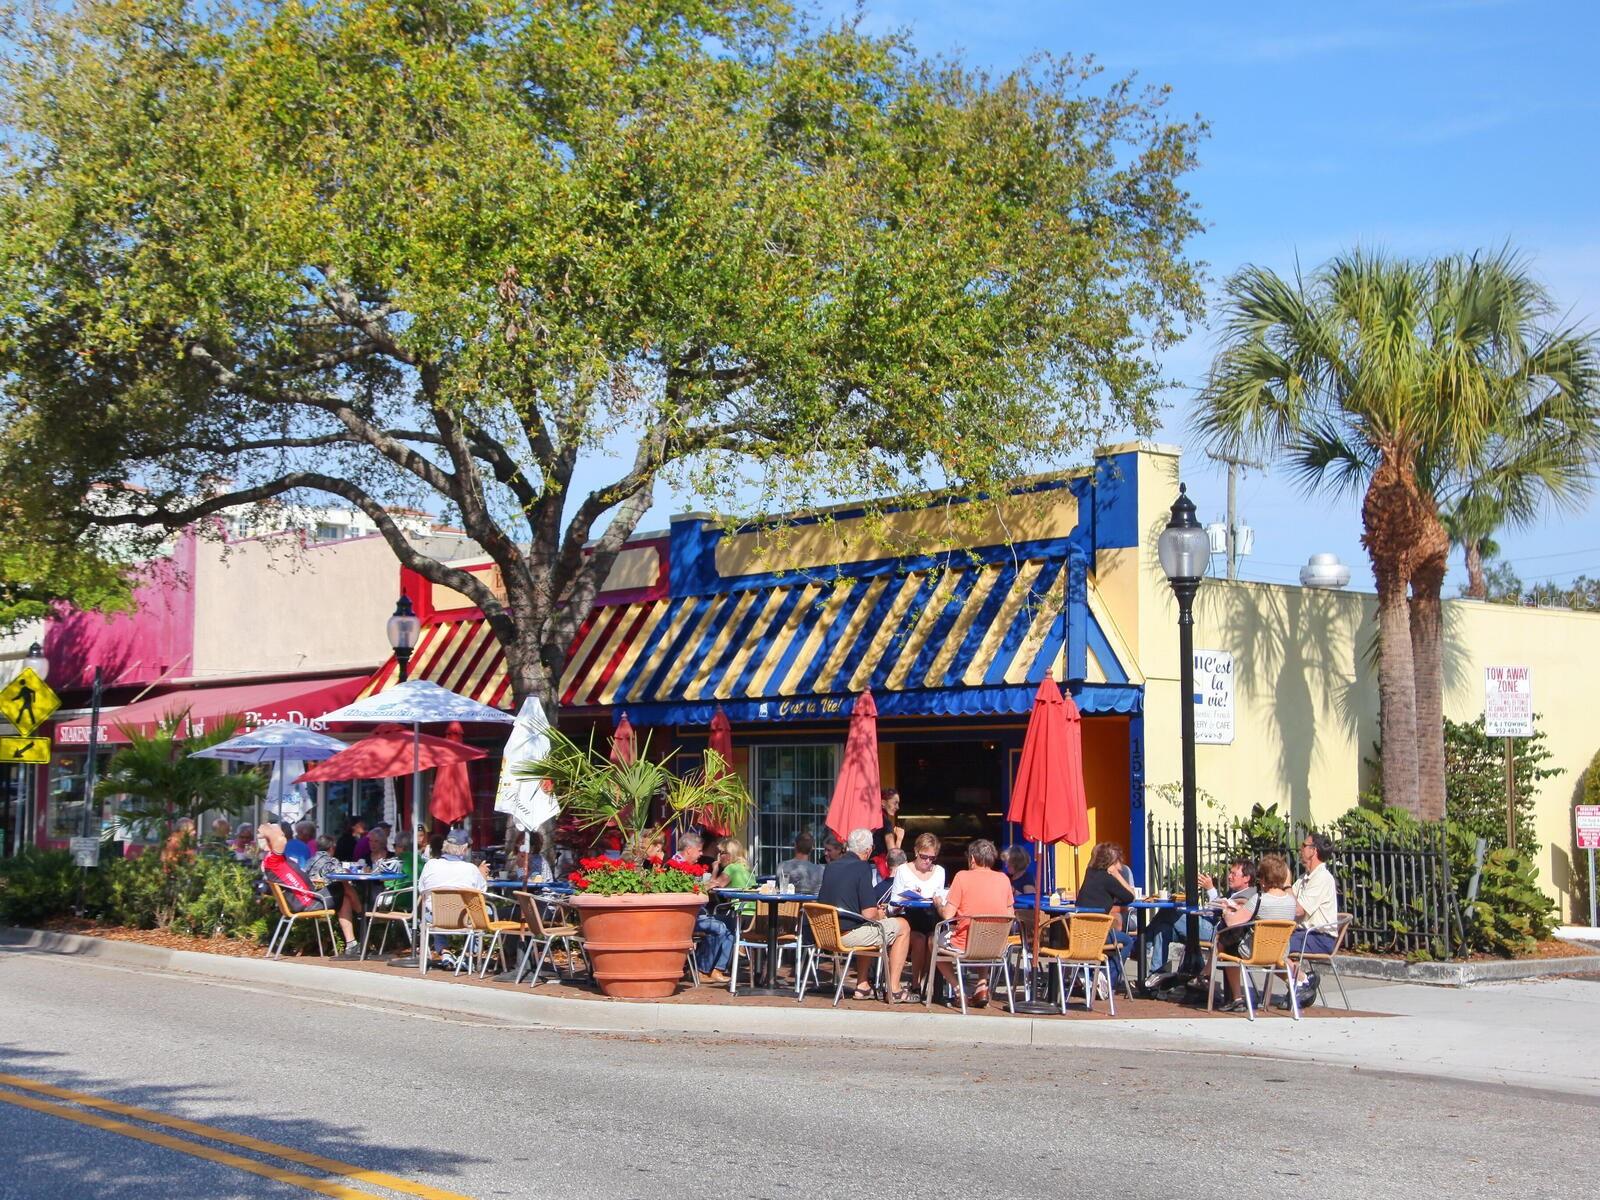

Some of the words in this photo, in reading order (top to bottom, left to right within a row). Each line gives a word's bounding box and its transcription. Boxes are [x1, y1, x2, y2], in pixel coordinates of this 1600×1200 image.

[1204, 656, 1232, 674] C'est
[1486, 667, 1504, 680] TOW
[1506, 667, 1528, 680] AWAY
[1211, 674, 1224, 690] la
[1497, 680, 1518, 692] ZONE
[820, 698, 843, 713] Vie!
[1207, 691, 1228, 707] vie!
[287, 711, 330, 731] Dust
